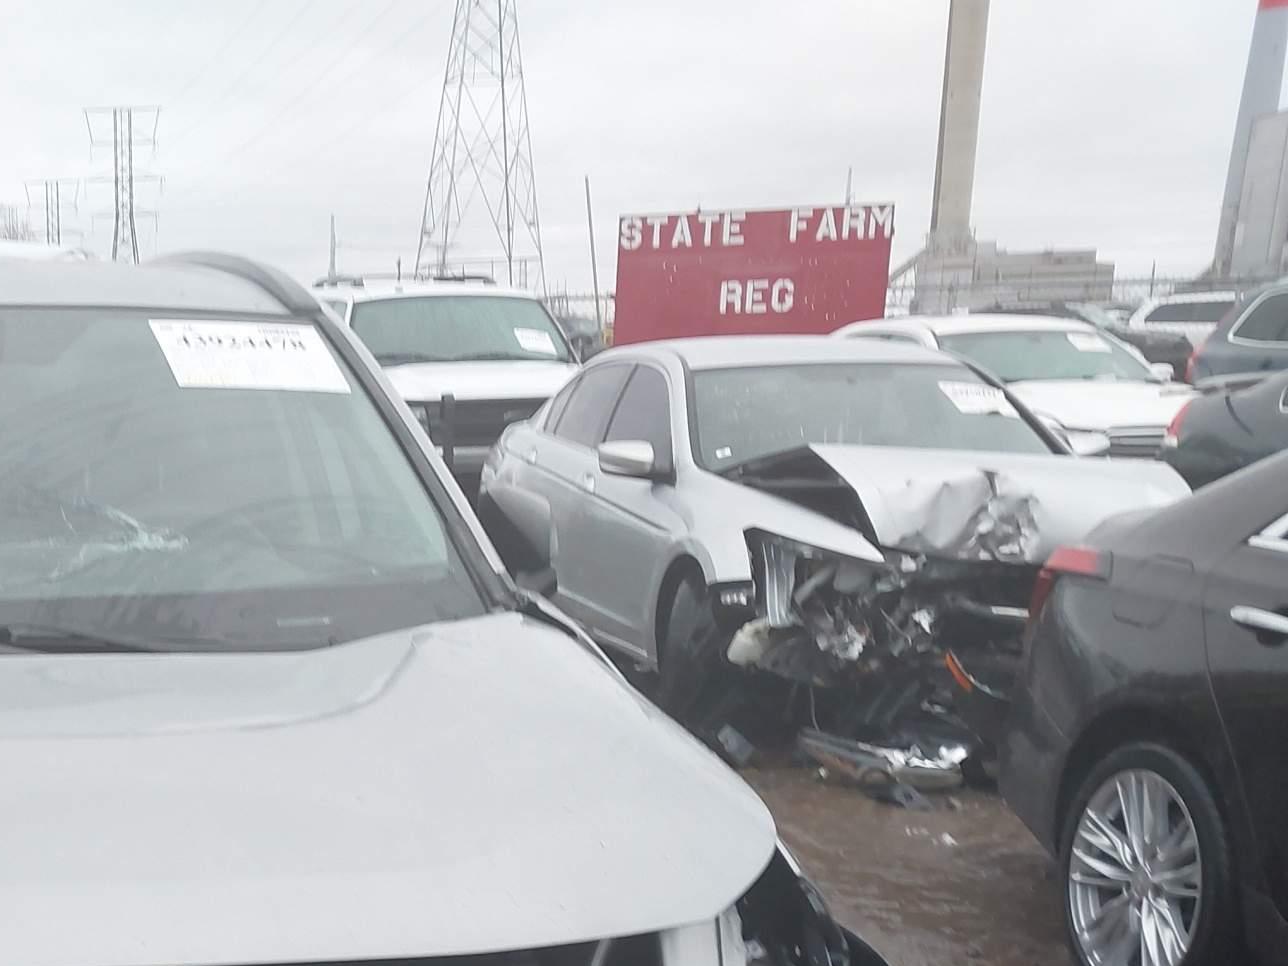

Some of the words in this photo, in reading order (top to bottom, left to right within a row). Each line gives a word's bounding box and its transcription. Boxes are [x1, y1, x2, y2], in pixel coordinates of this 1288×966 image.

[620, 210, 746, 250] STATE
[789, 205, 893, 244] FARM
[719, 277, 795, 315] REG
